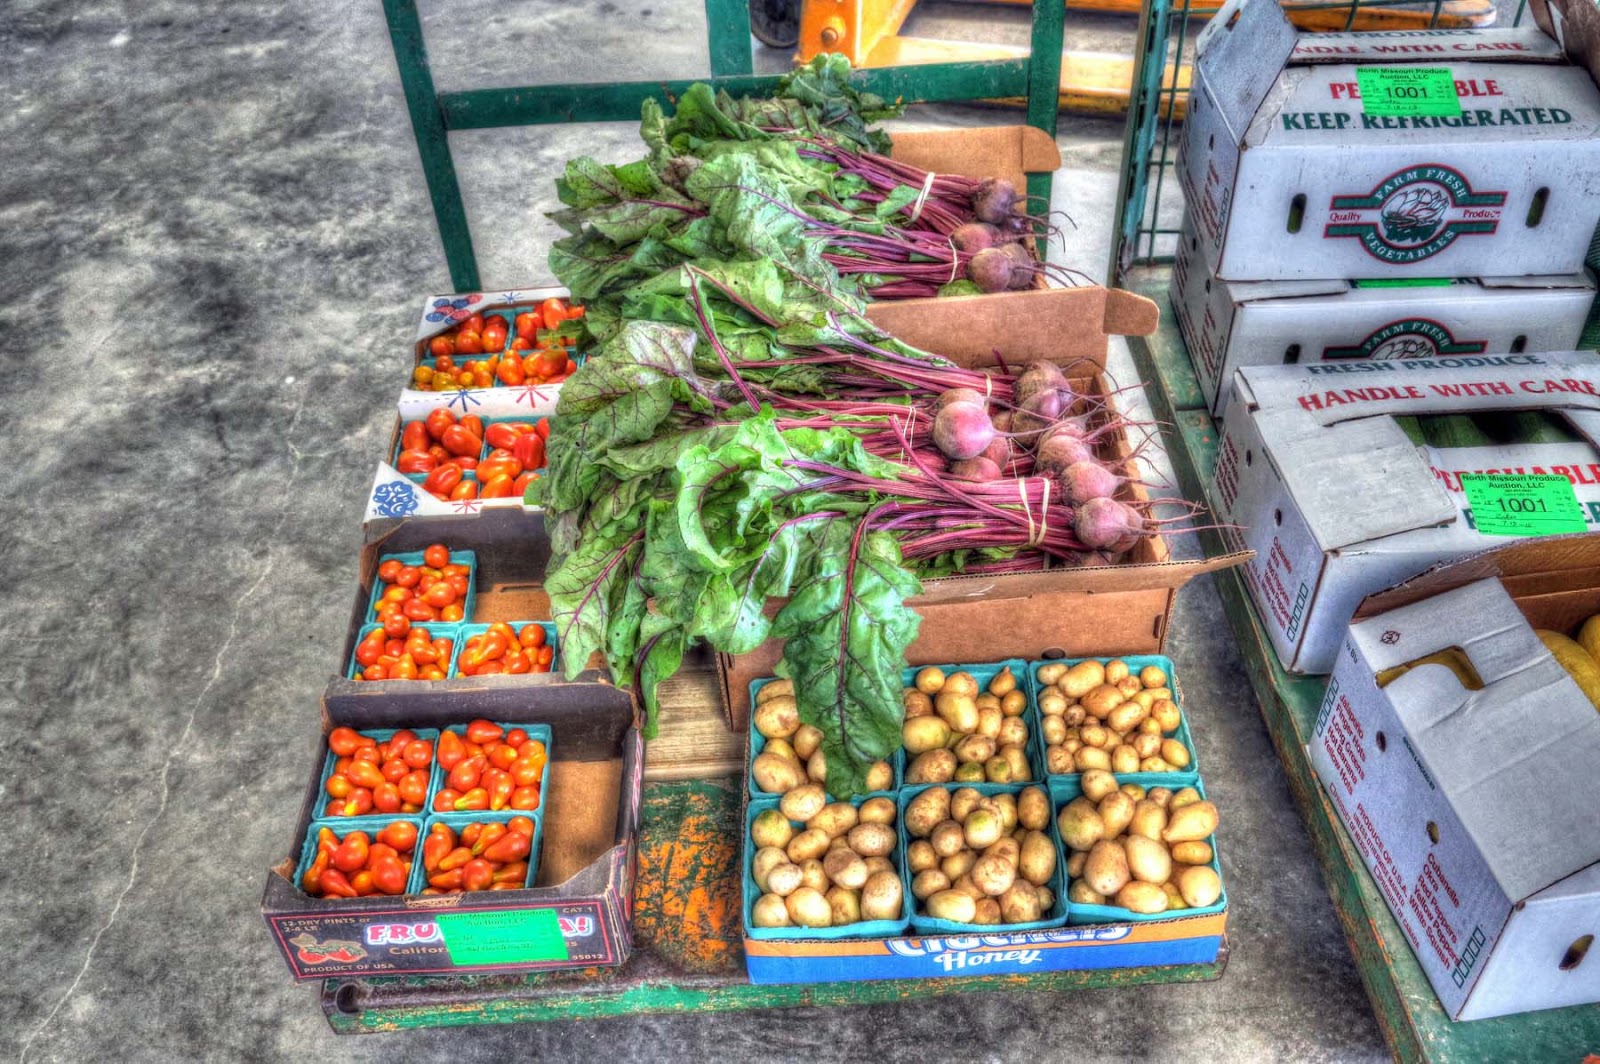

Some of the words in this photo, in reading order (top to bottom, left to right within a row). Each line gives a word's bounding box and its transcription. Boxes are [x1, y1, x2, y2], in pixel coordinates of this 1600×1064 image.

[1295, 46, 1365, 54] NDLE
[1371, 45, 1446, 53] WITH
[1452, 42, 1530, 51] CARE
[1386, 86, 1428, 99] 1001
[1281, 112, 1352, 131] KEEP
[1375, 171, 1419, 200] FARM
[1425, 169, 1467, 198] FRESH
[1365, 230, 1455, 260] VEGETABLES
[1365, 324, 1405, 350] FARM
[1411, 321, 1450, 347] FRESH
[1306, 361, 1396, 375] FRESH
[1405, 355, 1546, 370] PRODUCE
[1297, 385, 1426, 411] HANDLE
[1431, 381, 1513, 398] WITH
[1518, 378, 1600, 396] CARE
[1496, 498, 1547, 513] 1001
[1331, 715, 1345, 744] Long
[1345, 741, 1364, 780] Greens
[1336, 704, 1352, 737] Finger
[1353, 735, 1365, 761] Hots
[1324, 736, 1339, 770] Yellow
[1340, 768, 1352, 795] Hots
[1328, 726, 1336, 745] Hot
[1337, 744, 1357, 784] Banana
[1357, 803, 1383, 851] PRODUCE
[1391, 866, 1408, 897] U.S.A.
[1423, 863, 1438, 892] Okra
[1427, 851, 1460, 909] Cubanelle
[562, 906, 583, 914] CAT
[1418, 874, 1431, 897] Red
[1430, 897, 1457, 945] Peppers
[1409, 895, 1426, 928] White
[1425, 926, 1450, 970] Squash
[1413, 885, 1433, 921] Yellow
[1432, 920, 1459, 966] Peppers
[389, 945, 449, 955] Califor
[932, 949, 1042, 972] Honey
[303, 964, 353, 973] PRODUCT
